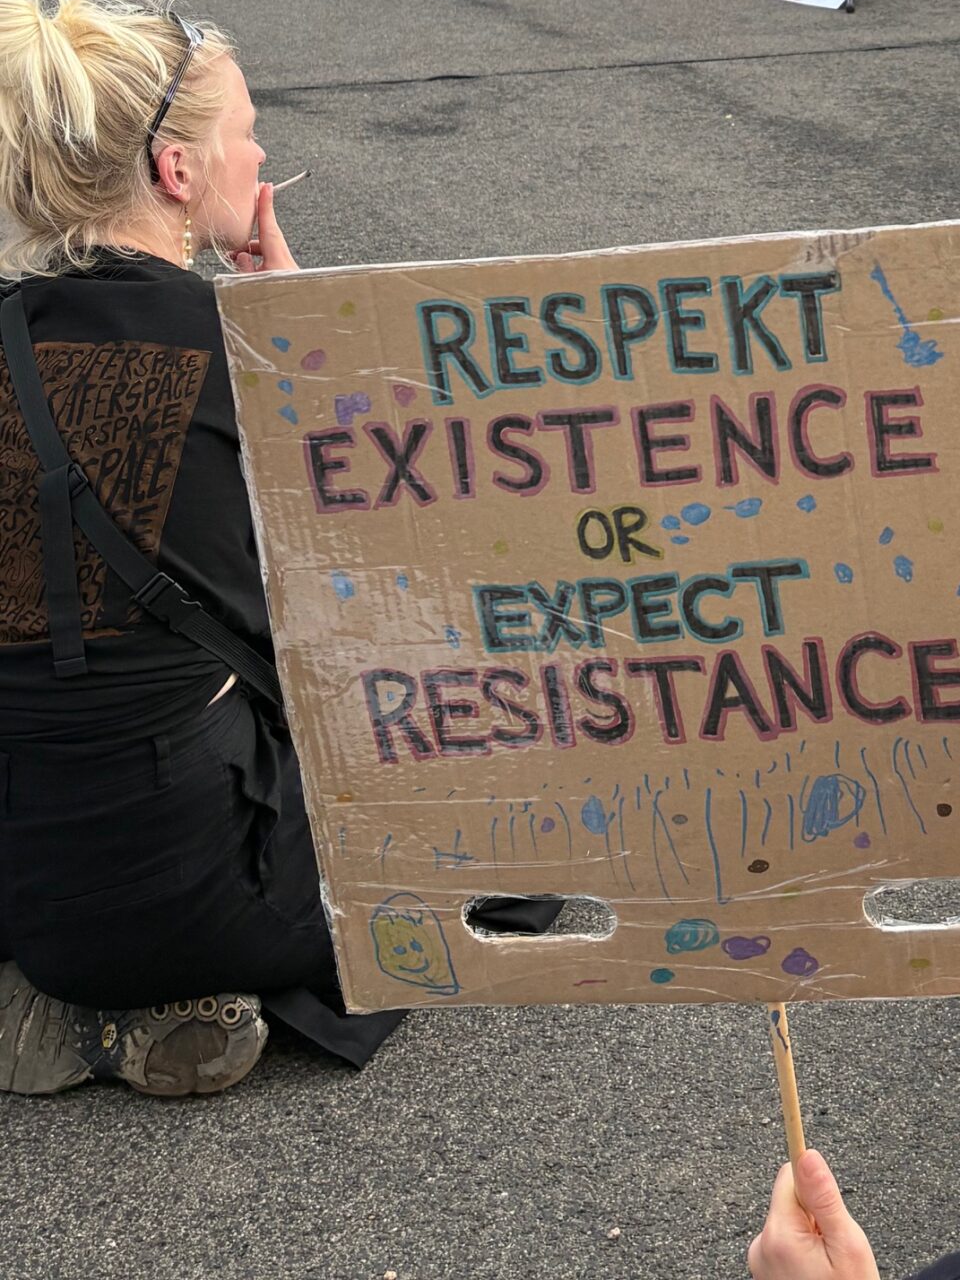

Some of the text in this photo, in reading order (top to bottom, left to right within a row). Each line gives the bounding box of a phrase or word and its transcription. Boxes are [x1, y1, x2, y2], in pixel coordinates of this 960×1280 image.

[415, 271, 842, 406] RESPEKT
[302, 383, 940, 513] EXISTENCE
[575, 505, 665, 565] OR
[472, 558, 810, 654] EXPECT
